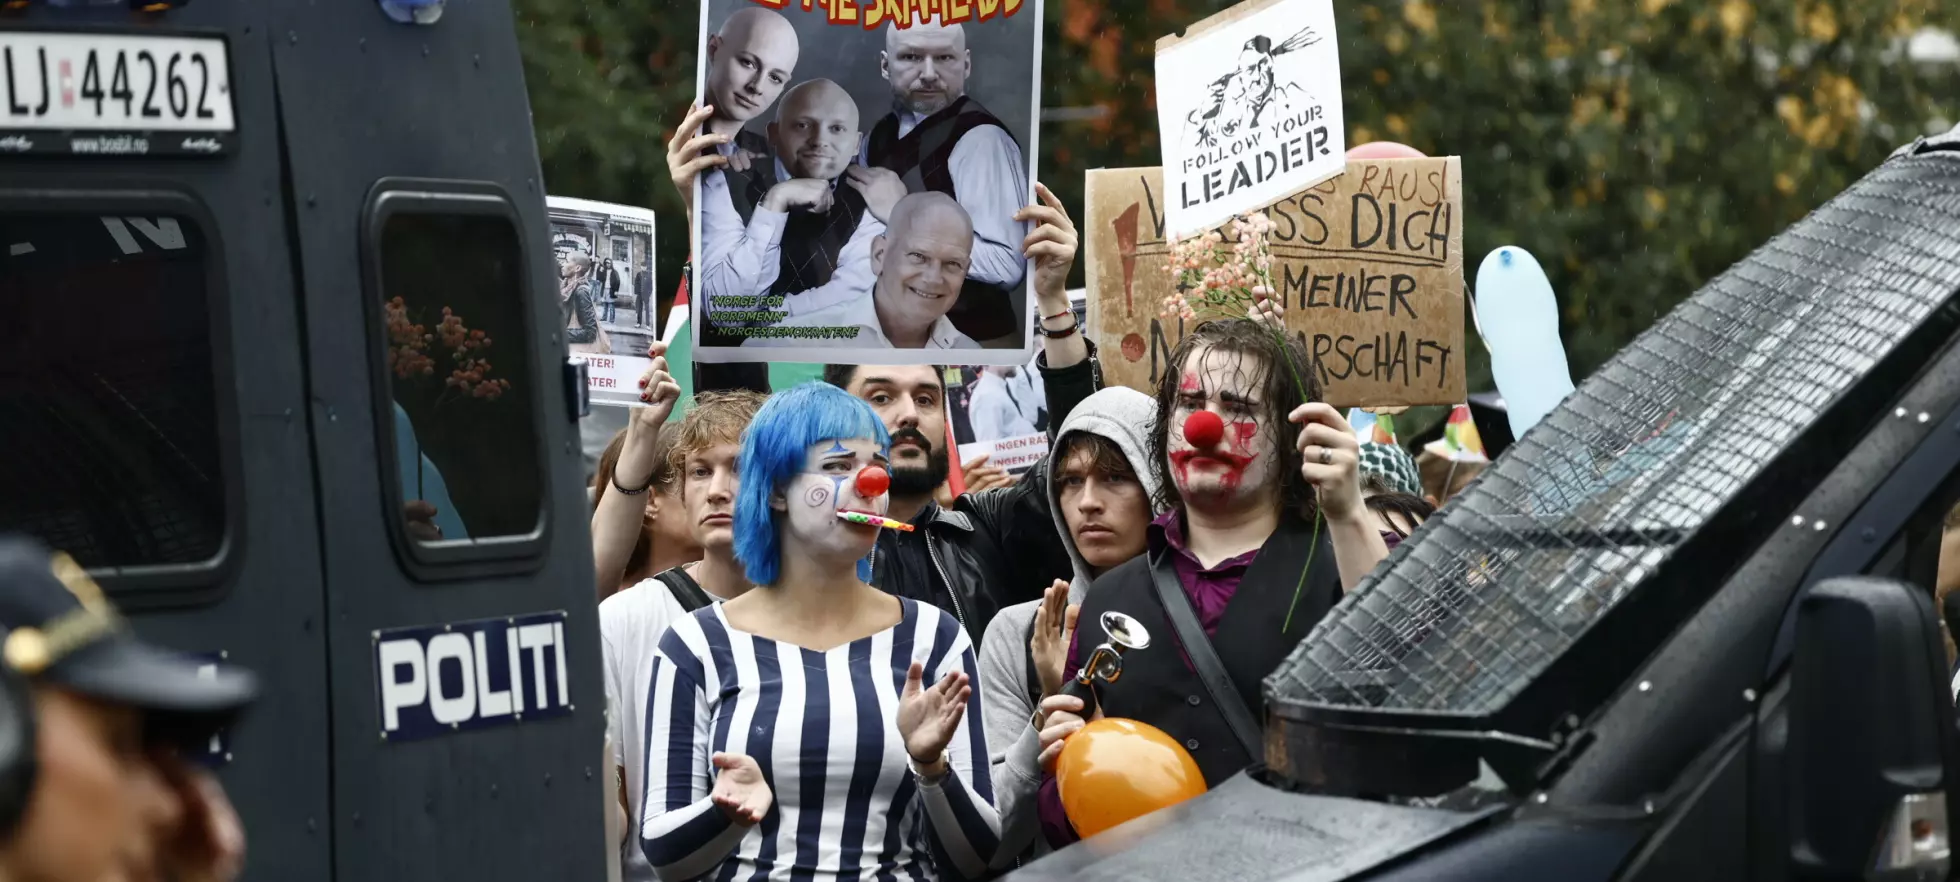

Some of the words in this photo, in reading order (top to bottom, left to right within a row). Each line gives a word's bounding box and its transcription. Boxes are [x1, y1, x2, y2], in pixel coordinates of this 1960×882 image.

[4, 45, 49, 116] LJ
[81, 49, 214, 119] 44262
[1183, 131, 1262, 174] FOLLOW
[1271, 105, 1323, 138] YOUR
[1181, 125, 1331, 210] LEADER
[1351, 193, 1451, 261] DICH
[759, 294, 784, 306] FOR
[1283, 263, 1419, 320] MEINER
[717, 326, 860, 339] NORGESDEMOKRATENE
[576, 356, 614, 368] ATER!
[587, 377, 617, 388] ATER!
[993, 455, 1025, 467] INGEN
[995, 439, 1027, 451] INGEN
[379, 621, 569, 731] POLITI
